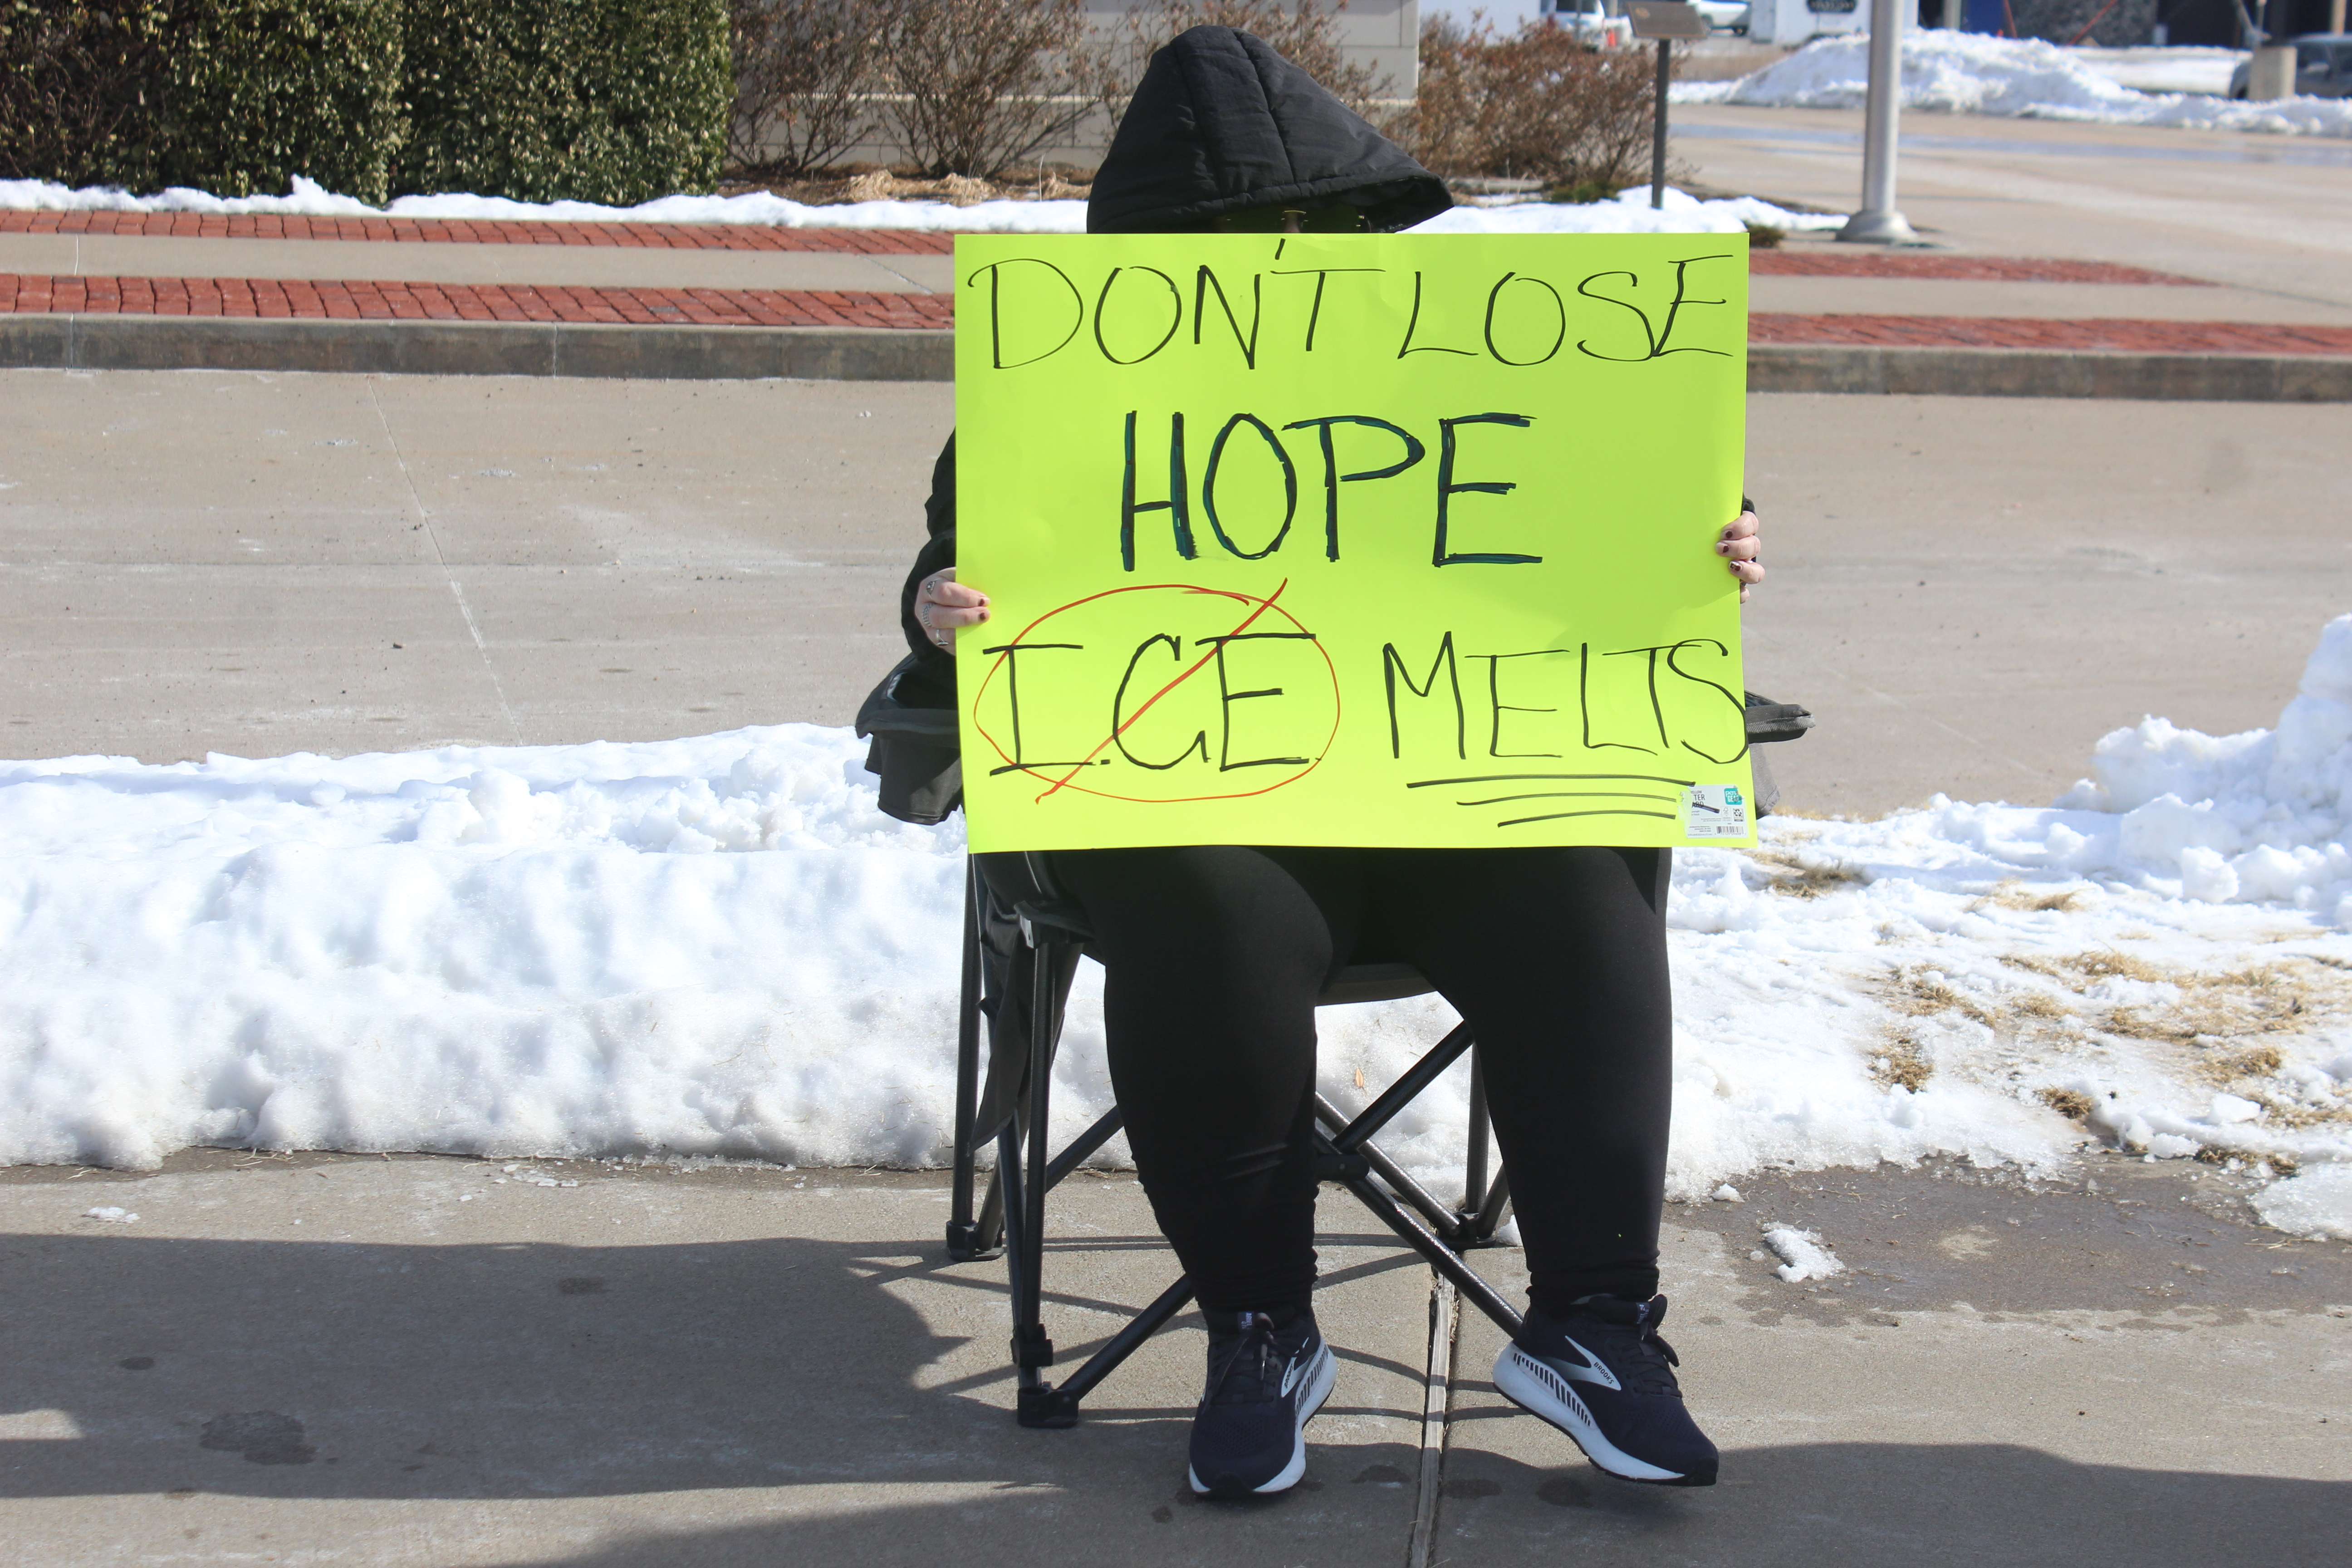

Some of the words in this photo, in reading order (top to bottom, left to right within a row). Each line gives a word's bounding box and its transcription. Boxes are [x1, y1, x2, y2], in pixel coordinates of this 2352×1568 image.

[967, 238, 1386, 370] DON'T
[1397, 255, 1734, 366] LOSE
[1120, 410, 1543, 572] HOPE
[1382, 631, 1749, 764] MELTS
[1594, 1362, 1614, 1384] BROOKS
